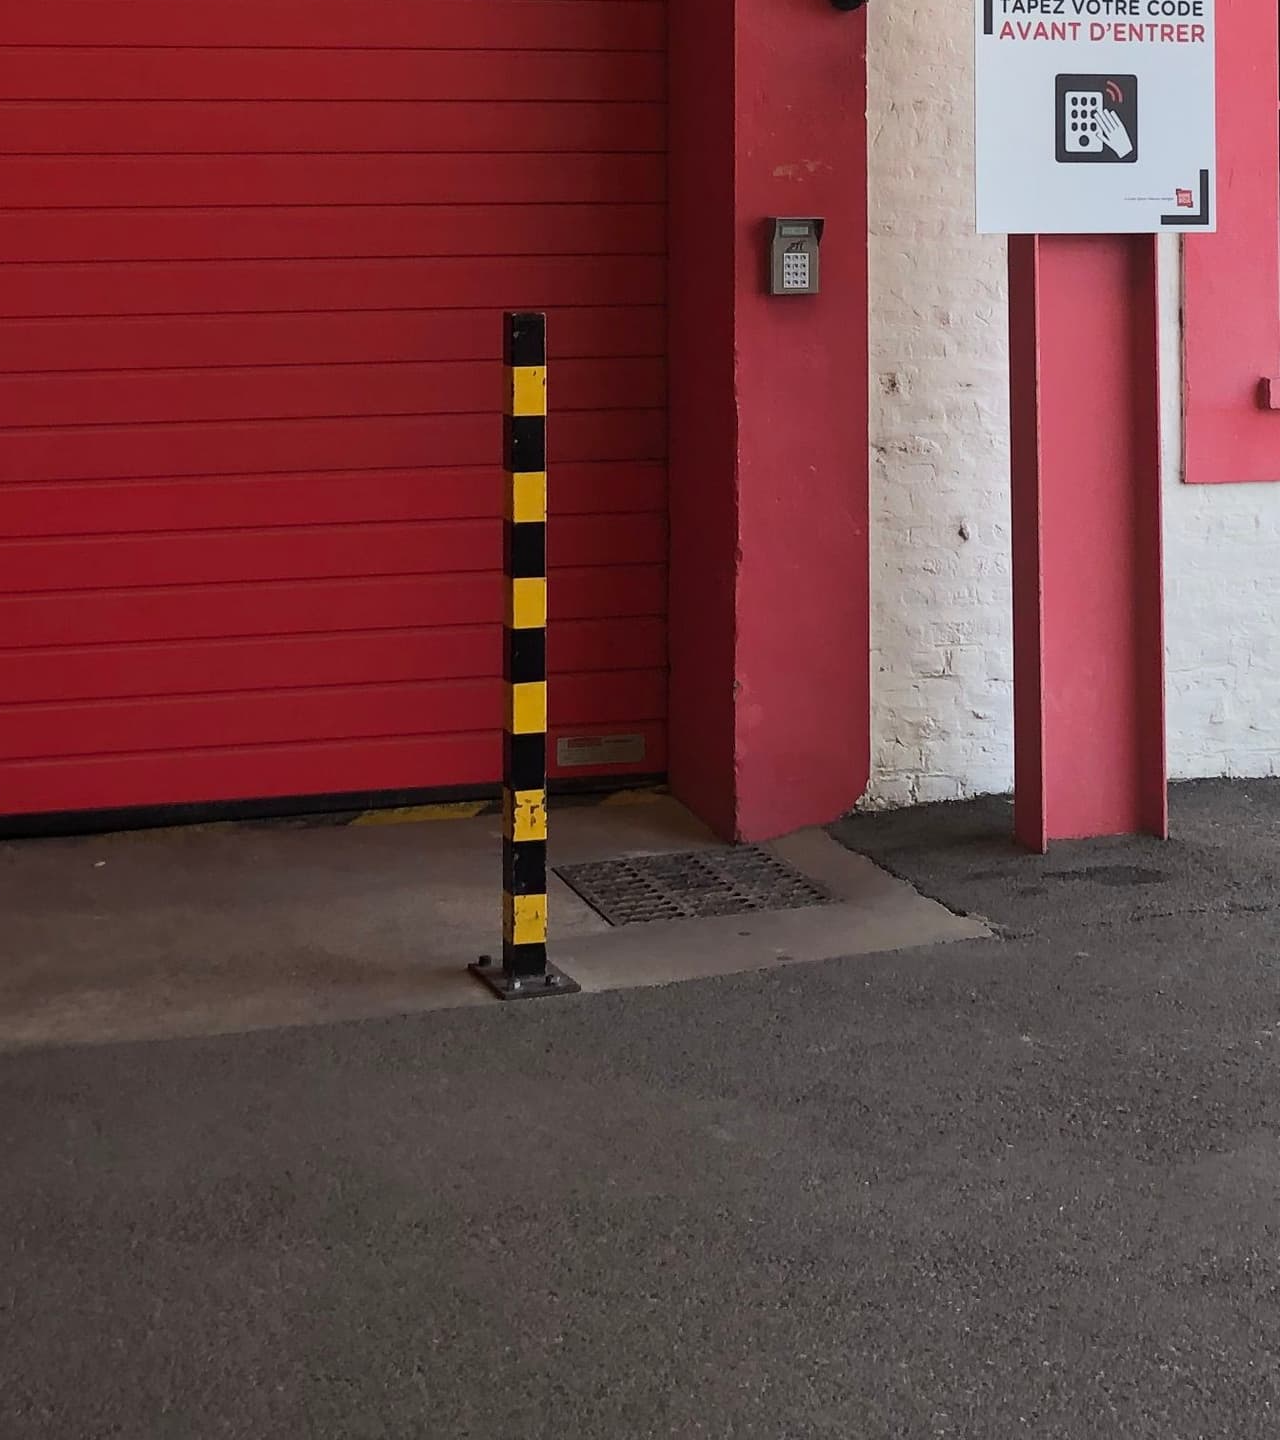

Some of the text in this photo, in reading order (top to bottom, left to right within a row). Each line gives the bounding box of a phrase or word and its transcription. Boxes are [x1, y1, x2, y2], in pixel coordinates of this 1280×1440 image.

[1072, 0, 1140, 16] VOTRE
[1147, 0, 1204, 17] CODE
[999, 21, 1205, 43] AVANT D'ENTRER
